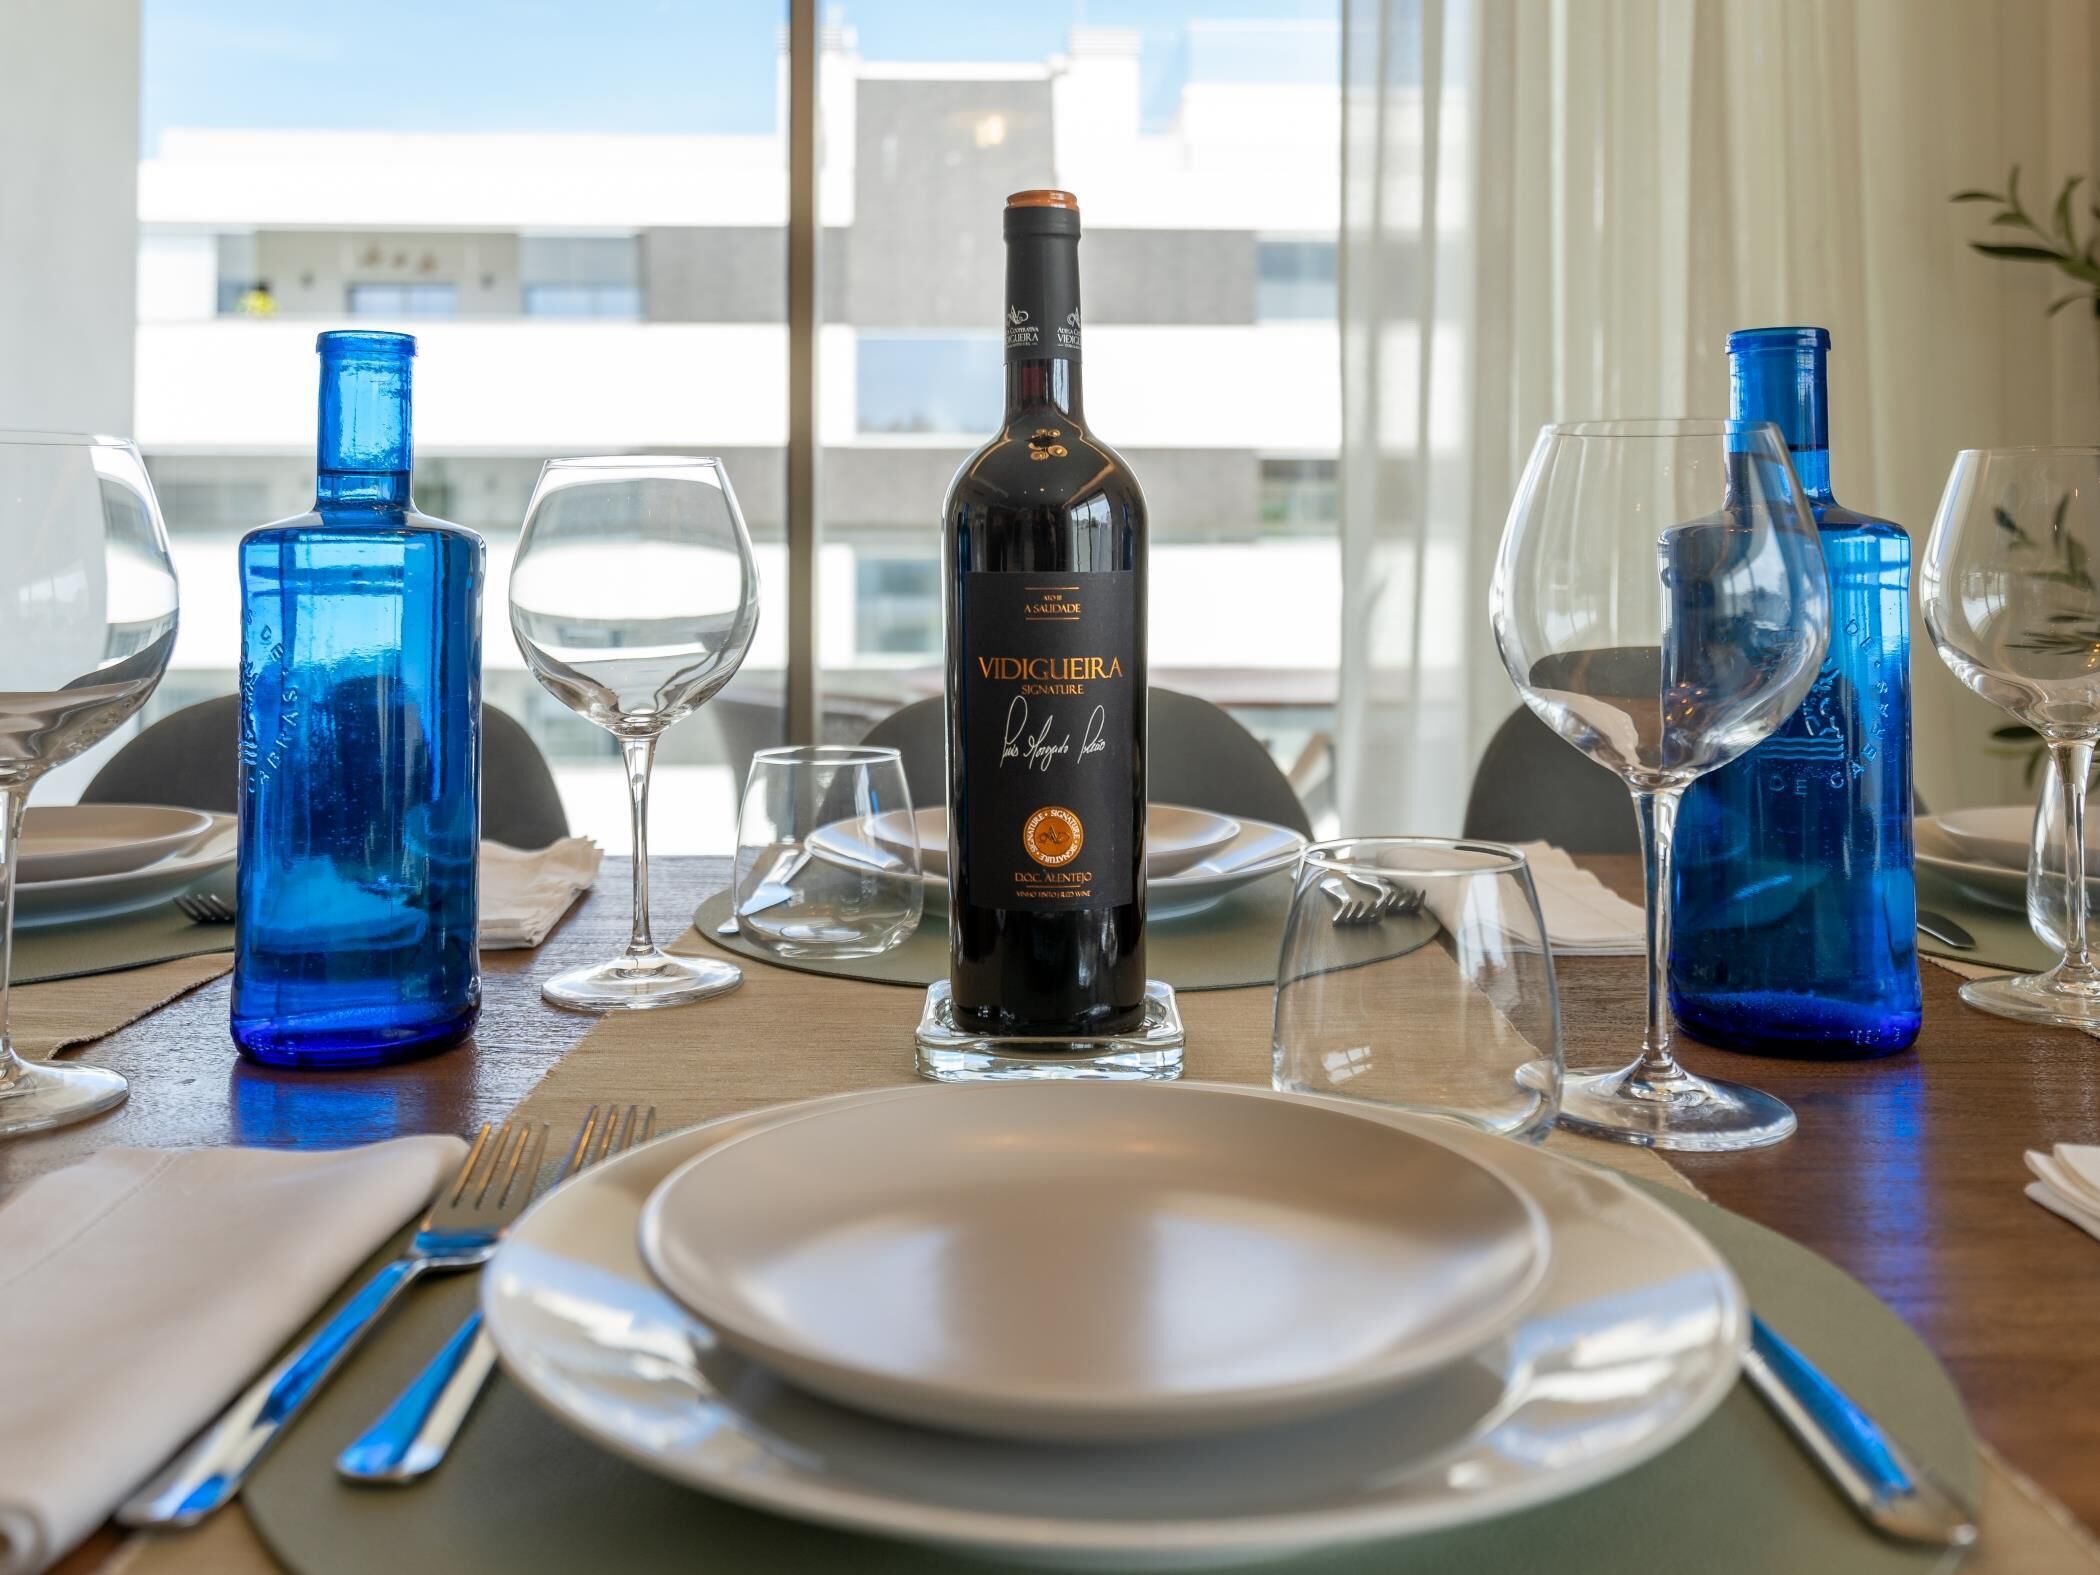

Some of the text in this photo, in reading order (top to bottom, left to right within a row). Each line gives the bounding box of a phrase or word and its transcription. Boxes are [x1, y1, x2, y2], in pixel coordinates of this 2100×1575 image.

[1024, 603, 1081, 614] A SAUDADE
[978, 656, 1123, 679] VIDIGUEIRA
[1021, 684, 1085, 695] SIGNATURE
[1027, 813, 1045, 853] SIGNATURE
[1050, 809, 1081, 840] SIGNATURE
[1040, 843, 1079, 864] SIGNATURE
[1044, 872, 1092, 884] ALENTEJO
